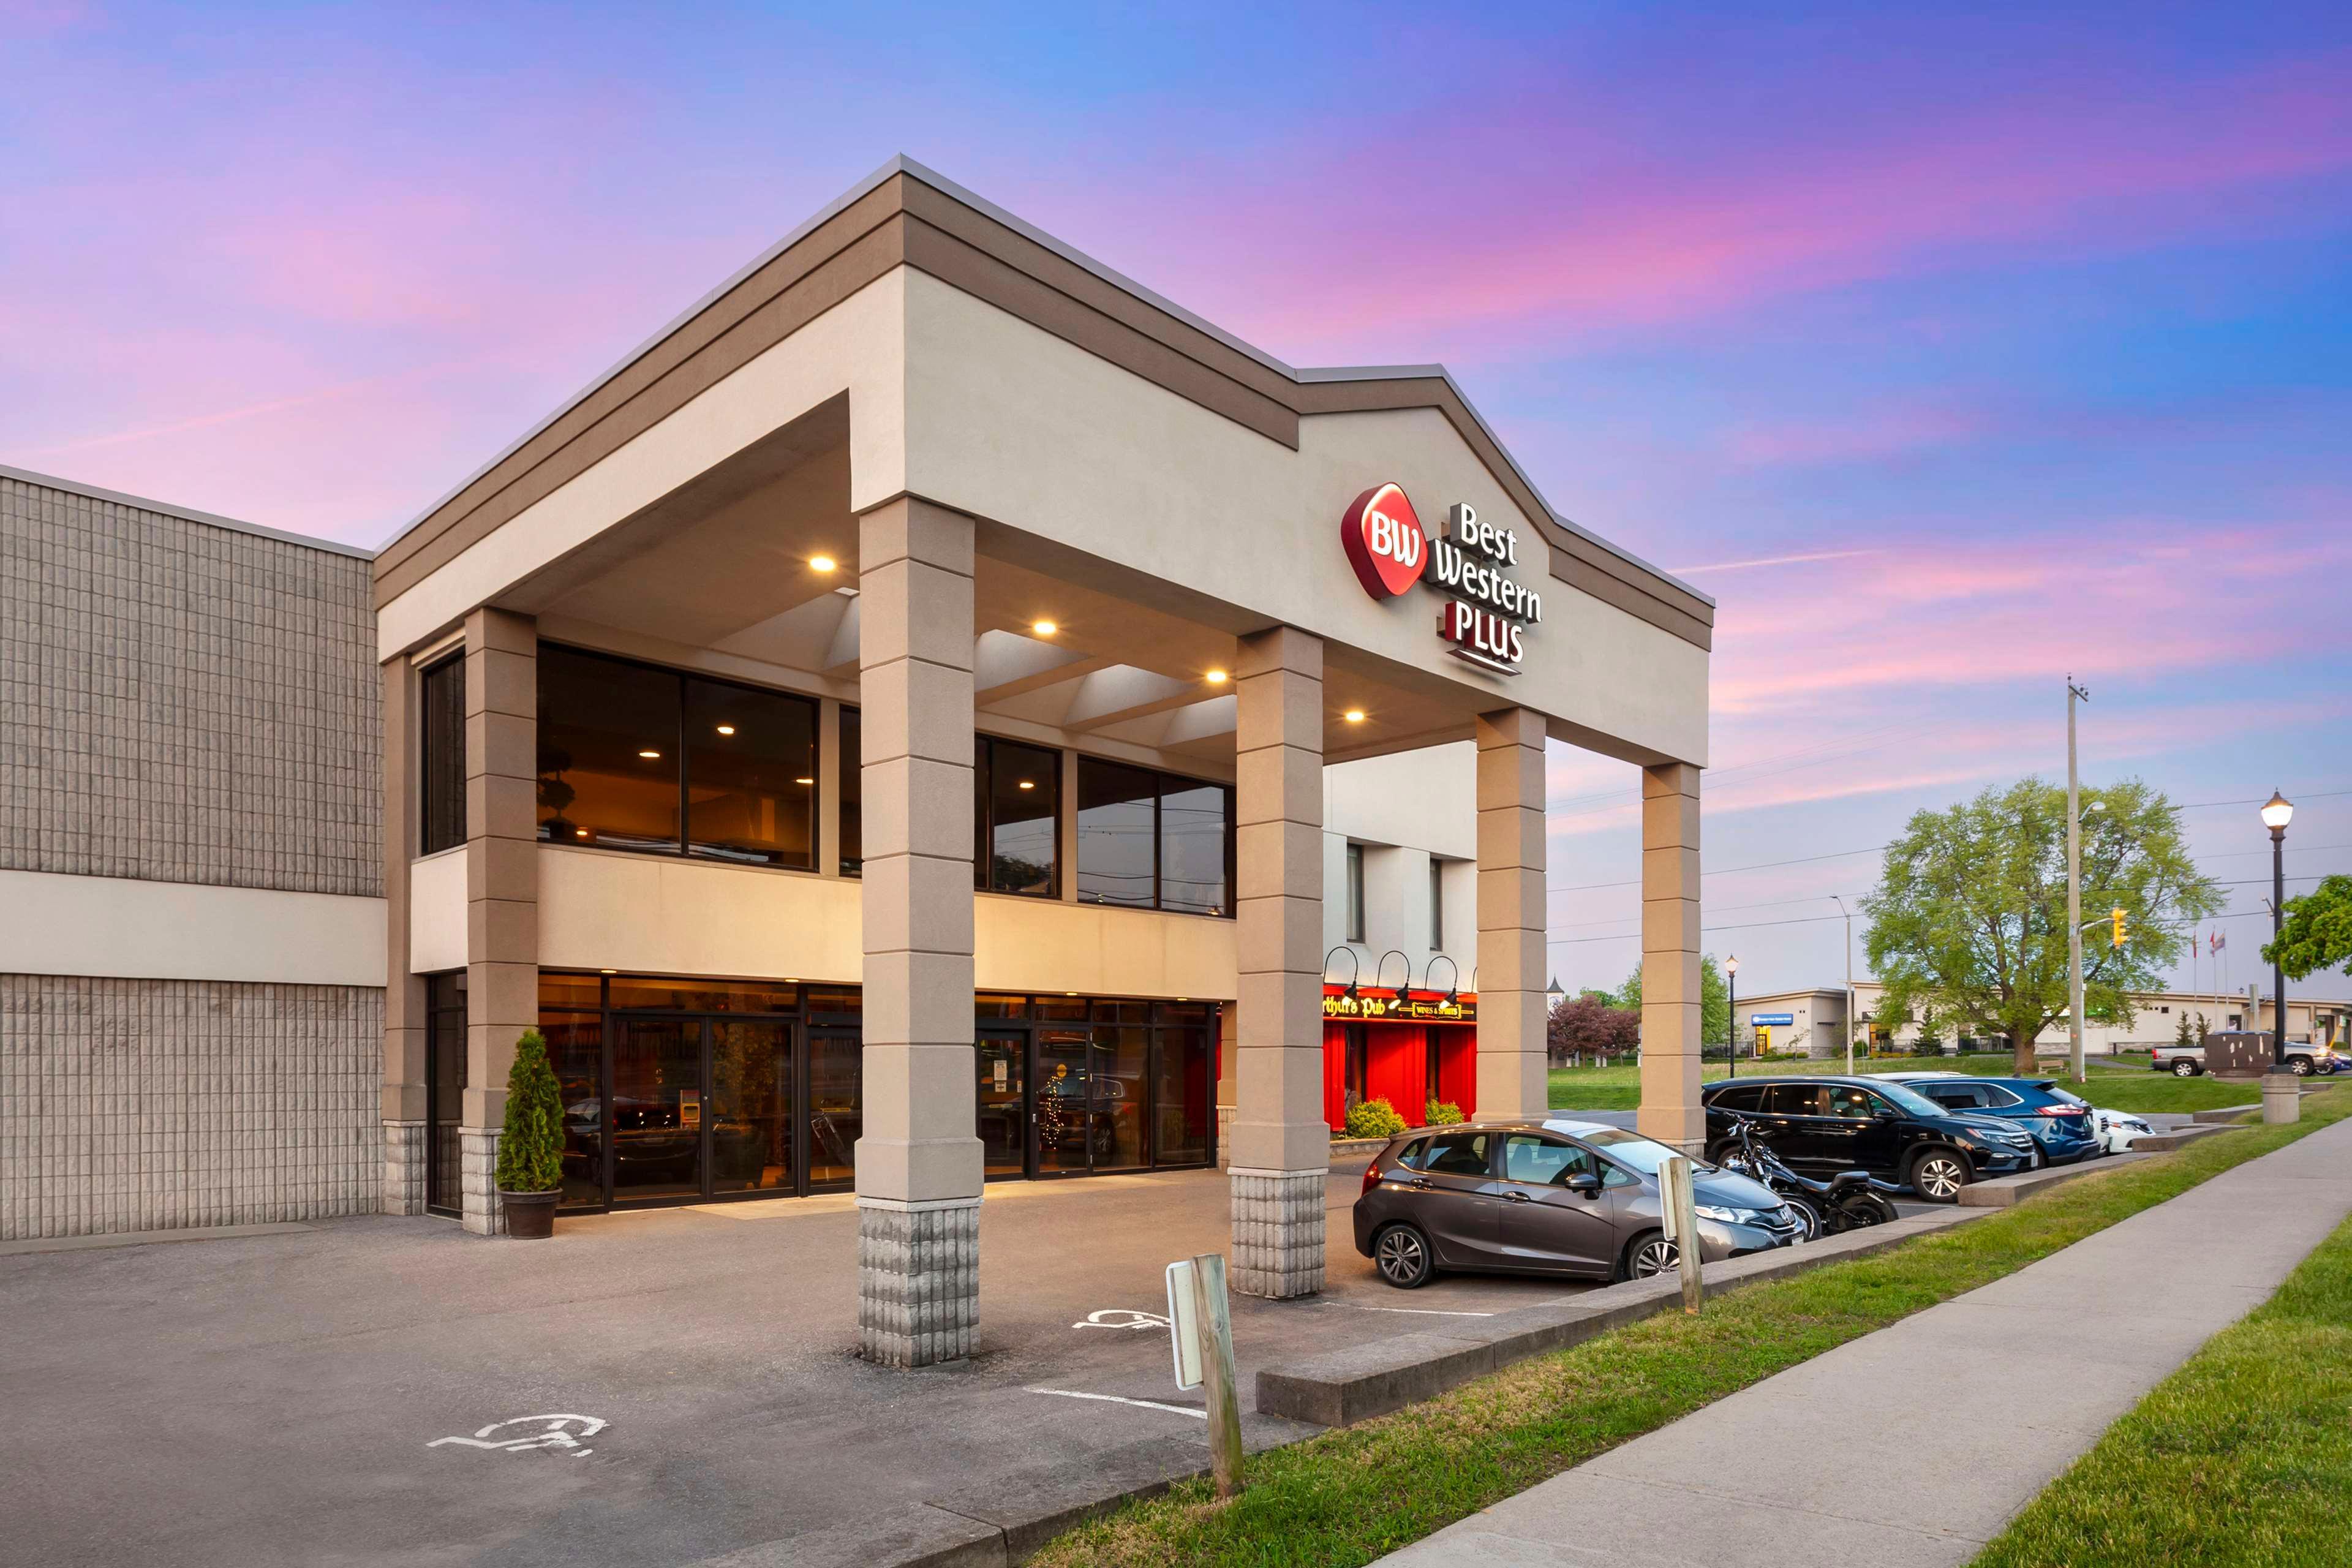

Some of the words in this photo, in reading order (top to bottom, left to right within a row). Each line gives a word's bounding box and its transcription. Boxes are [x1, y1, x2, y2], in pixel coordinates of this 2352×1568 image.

[1371, 510, 1419, 567] BW
[1460, 502, 1518, 566] Best
[1434, 538, 1542, 623] Western
[1455, 600, 1523, 663] PLUS
[1322, 995, 1358, 1017] rthur's
[1360, 997, 1385, 1018] Pub
[1417, 1006, 1433, 1015] WINES
